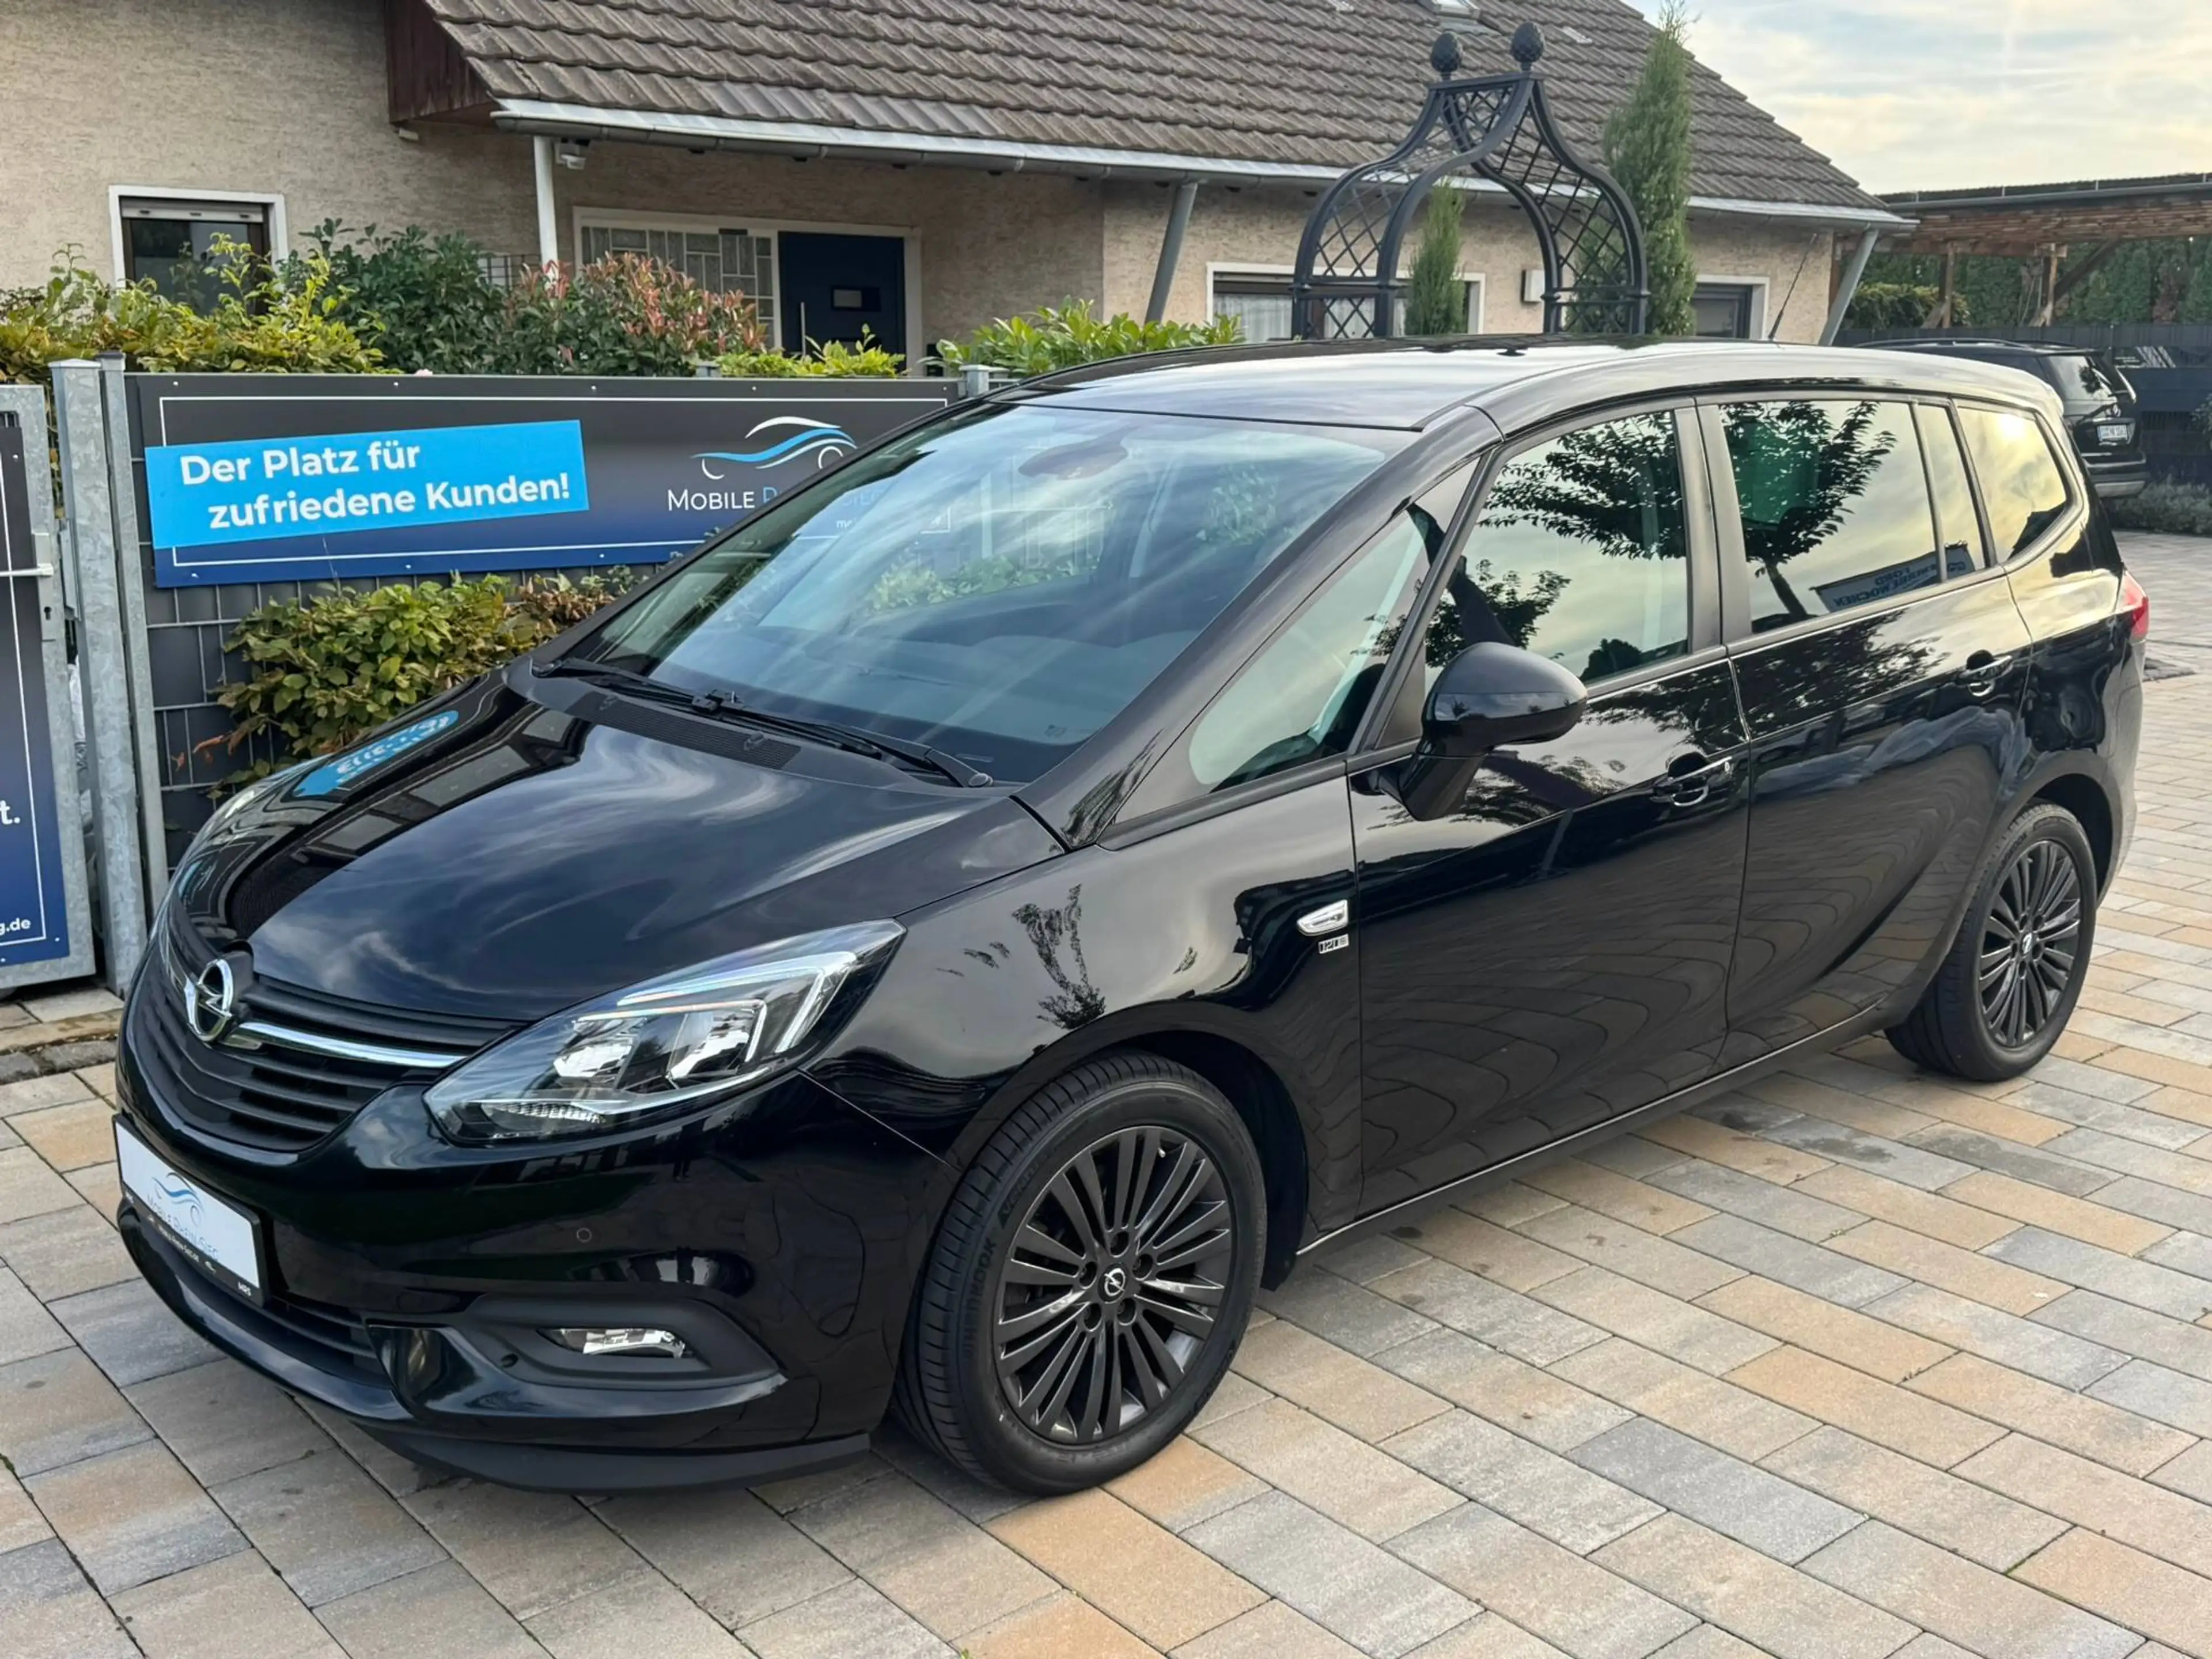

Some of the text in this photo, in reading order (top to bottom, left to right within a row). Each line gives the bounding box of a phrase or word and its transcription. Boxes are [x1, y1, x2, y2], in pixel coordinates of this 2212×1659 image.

[179, 440, 421, 486] Der Platz für
[207, 472, 570, 529] zufriedene Kunden!
[667, 488, 756, 512] MOBILE
